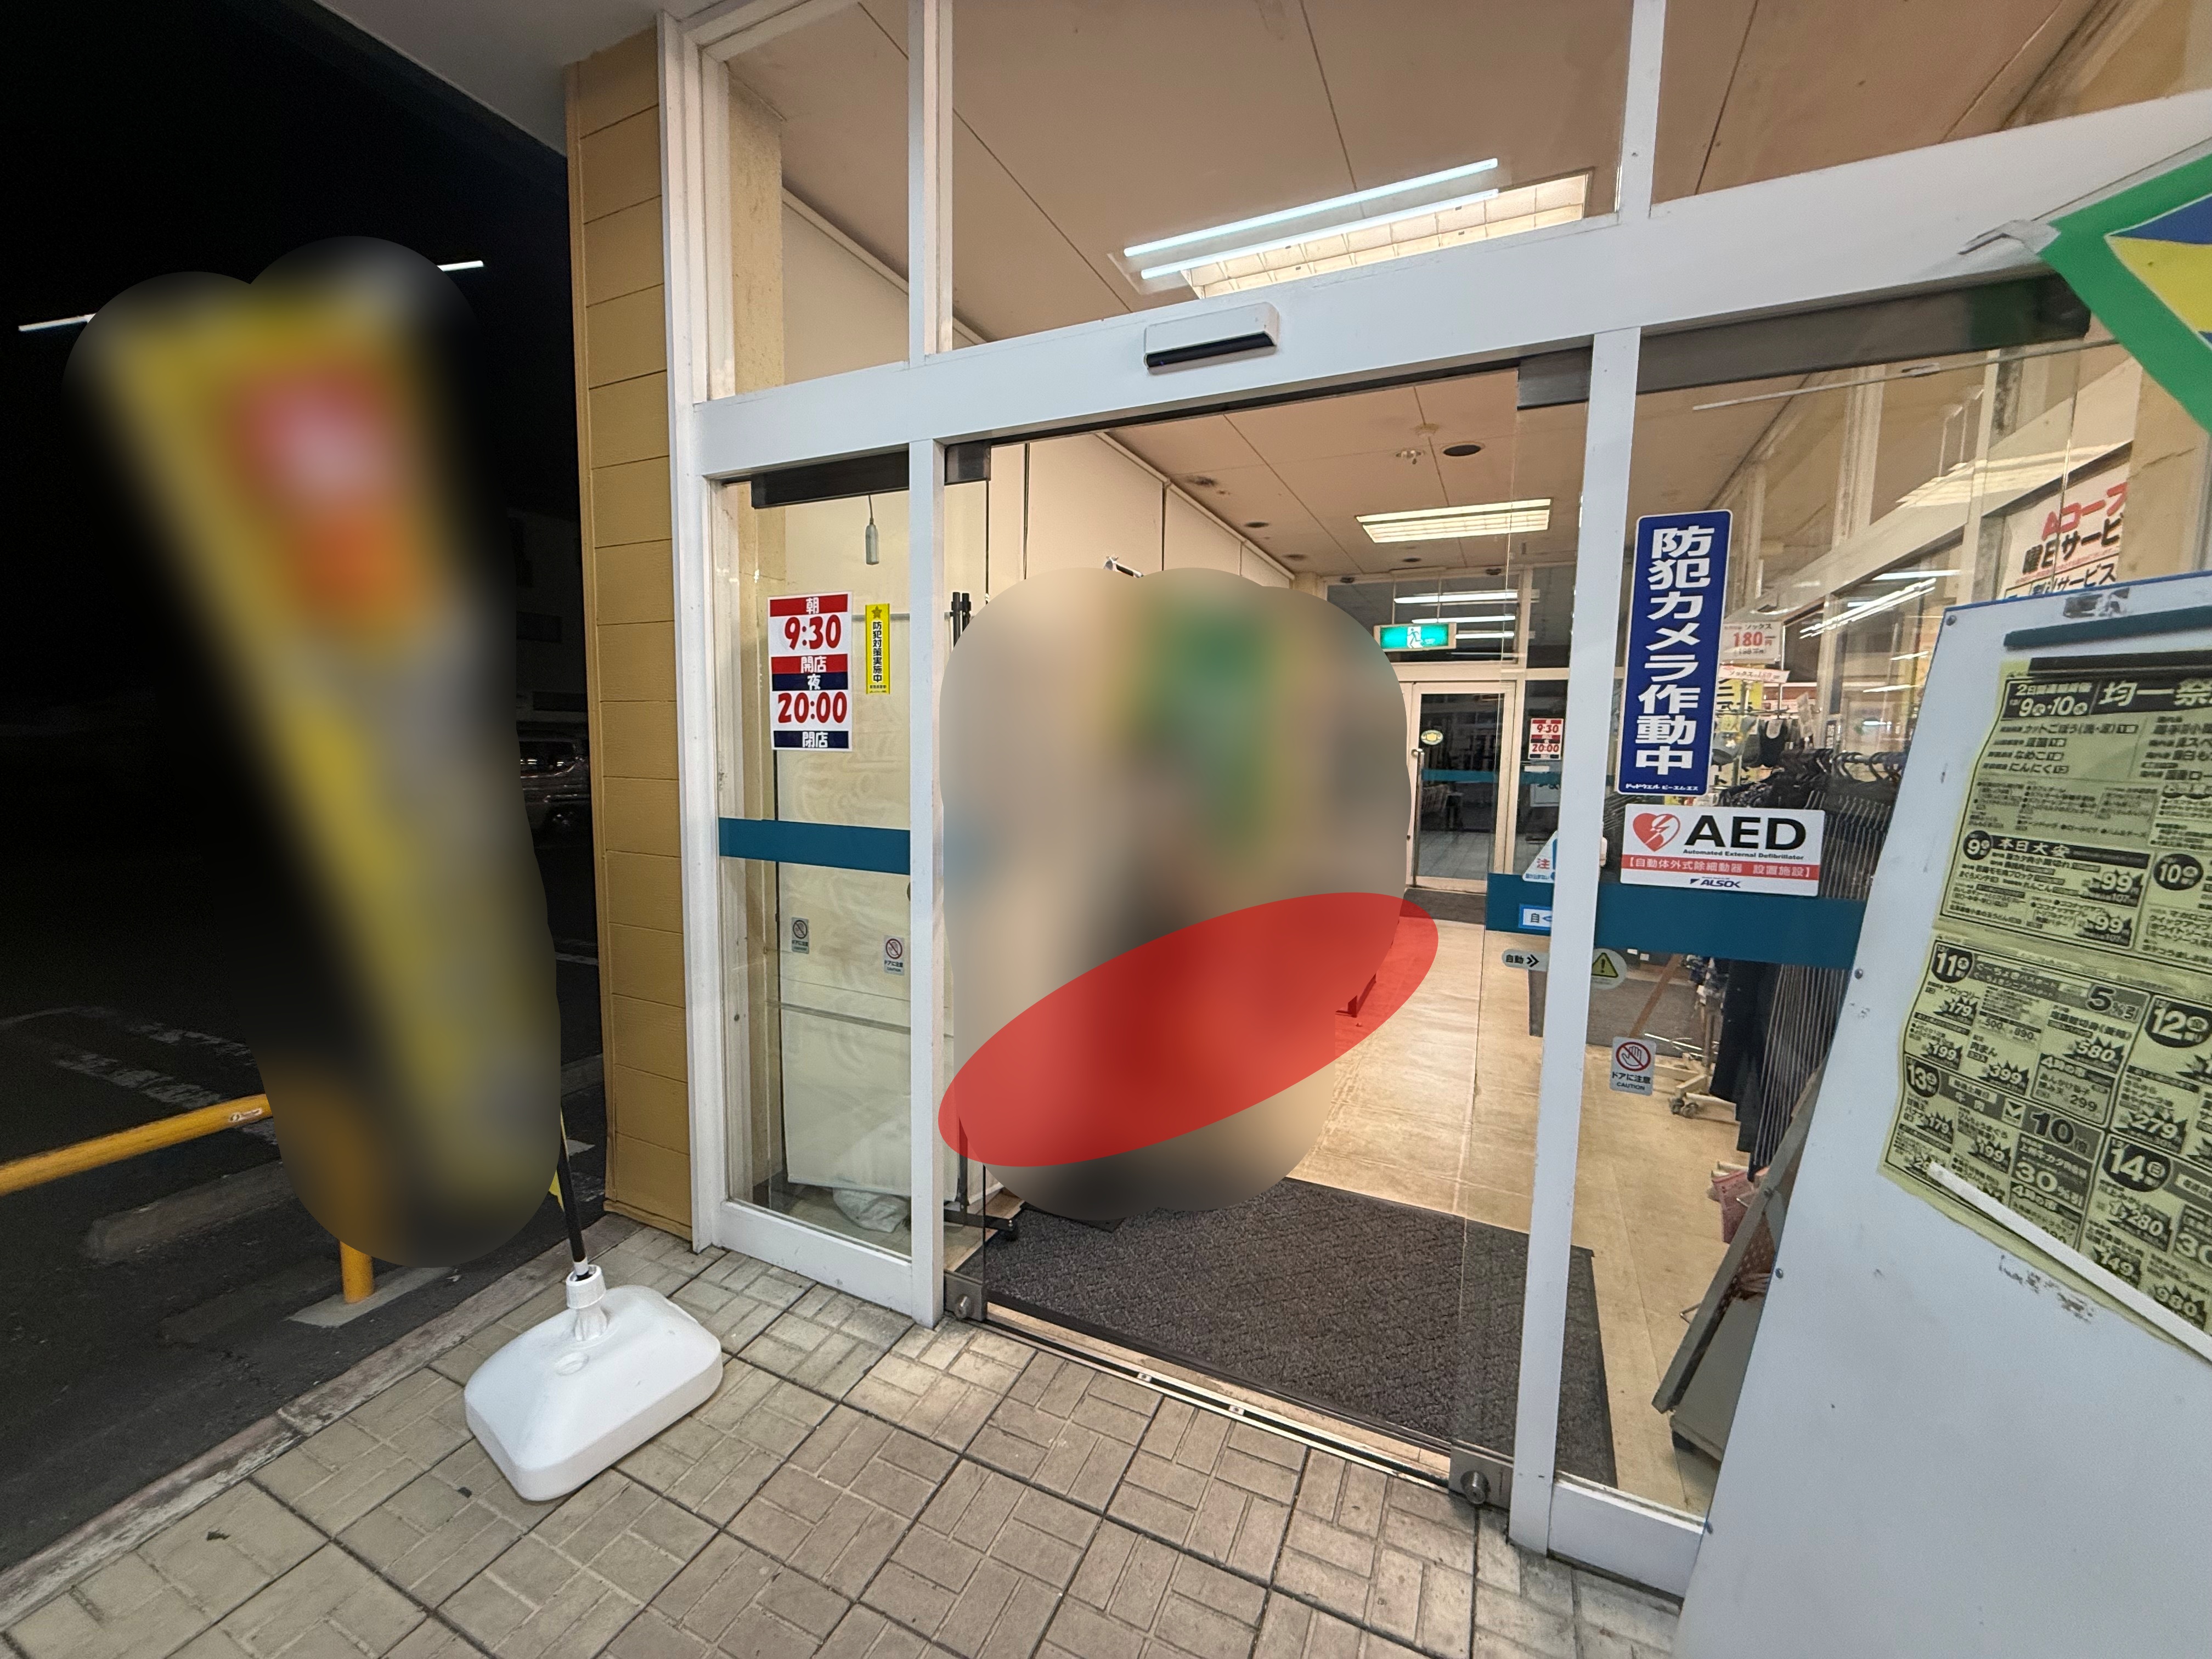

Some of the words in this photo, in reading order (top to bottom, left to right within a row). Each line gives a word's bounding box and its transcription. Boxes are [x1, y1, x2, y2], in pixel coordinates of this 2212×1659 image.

[806, 597, 820, 614] 朝
[785, 614, 841, 650] 9:30
[872, 621, 882, 683] 防犯対策実施中
[1635, 525, 1715, 775] 防犯カメラ作動中
[801, 656, 827, 673] 開店
[808, 674, 821, 690] 夜
[778, 691, 848, 724] 20:00
[1537, 724, 1559, 733] 9:30
[802, 731, 828, 748] 閉店
[1532, 744, 1559, 752] 20:00
[1684, 815, 1807, 851] AED
[1701, 879, 1741, 889] ALSOK
[2101, 871, 2133, 893] 99
[2095, 915, 2124, 934] 99
[1505, 953, 1524, 964] 自動
[1936, 952, 1958, 977] 11
[1948, 1003, 1972, 1017] 179
[2152, 1007, 2187, 1040] 12
[1932, 1043, 1957, 1061] 199
[2076, 1040, 2116, 1063] 580
[1611, 1071, 1651, 1085] ドアに注意
[1908, 1064, 1927, 1091] 13
[1990, 1065, 2022, 1085] 399
[1616, 1082, 1645, 1091] CAUTION
[1929, 1117, 1950, 1134] 179
[2132, 1113, 2179, 1139] 279
[2111, 1147, 2146, 1181] 14
